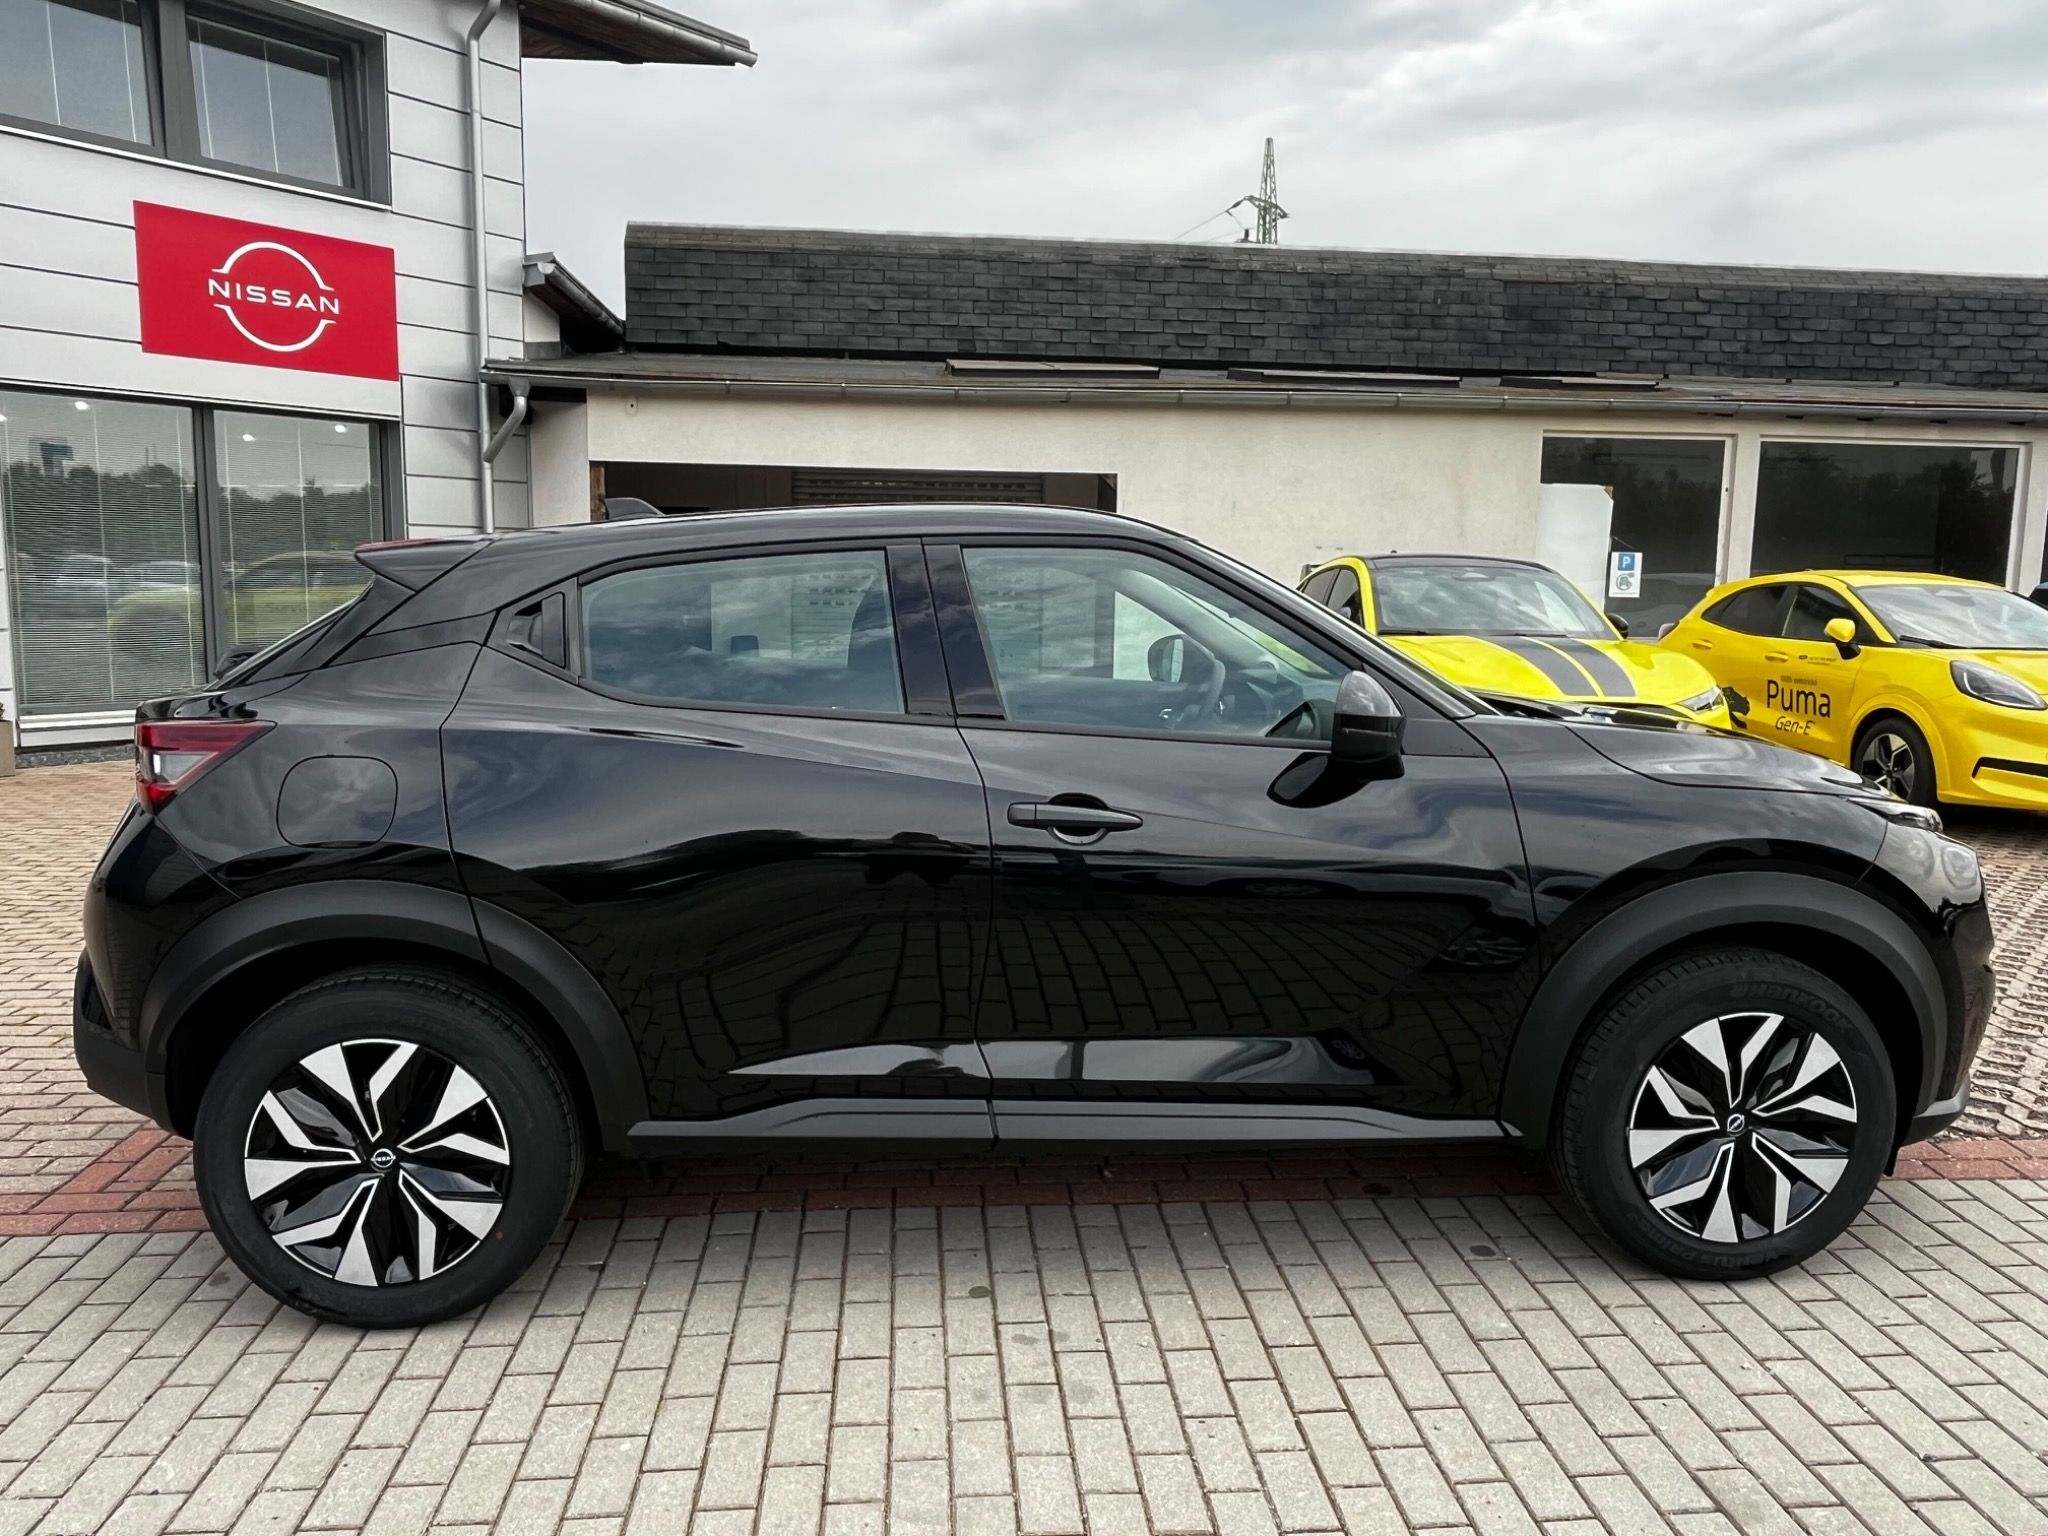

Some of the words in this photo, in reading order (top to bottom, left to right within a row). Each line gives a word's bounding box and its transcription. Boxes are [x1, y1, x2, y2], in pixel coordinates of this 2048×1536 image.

[208, 278, 340, 315] NISSAN
[1766, 679, 1831, 718] Puma
[1775, 715, 1814, 736] Gen-E
